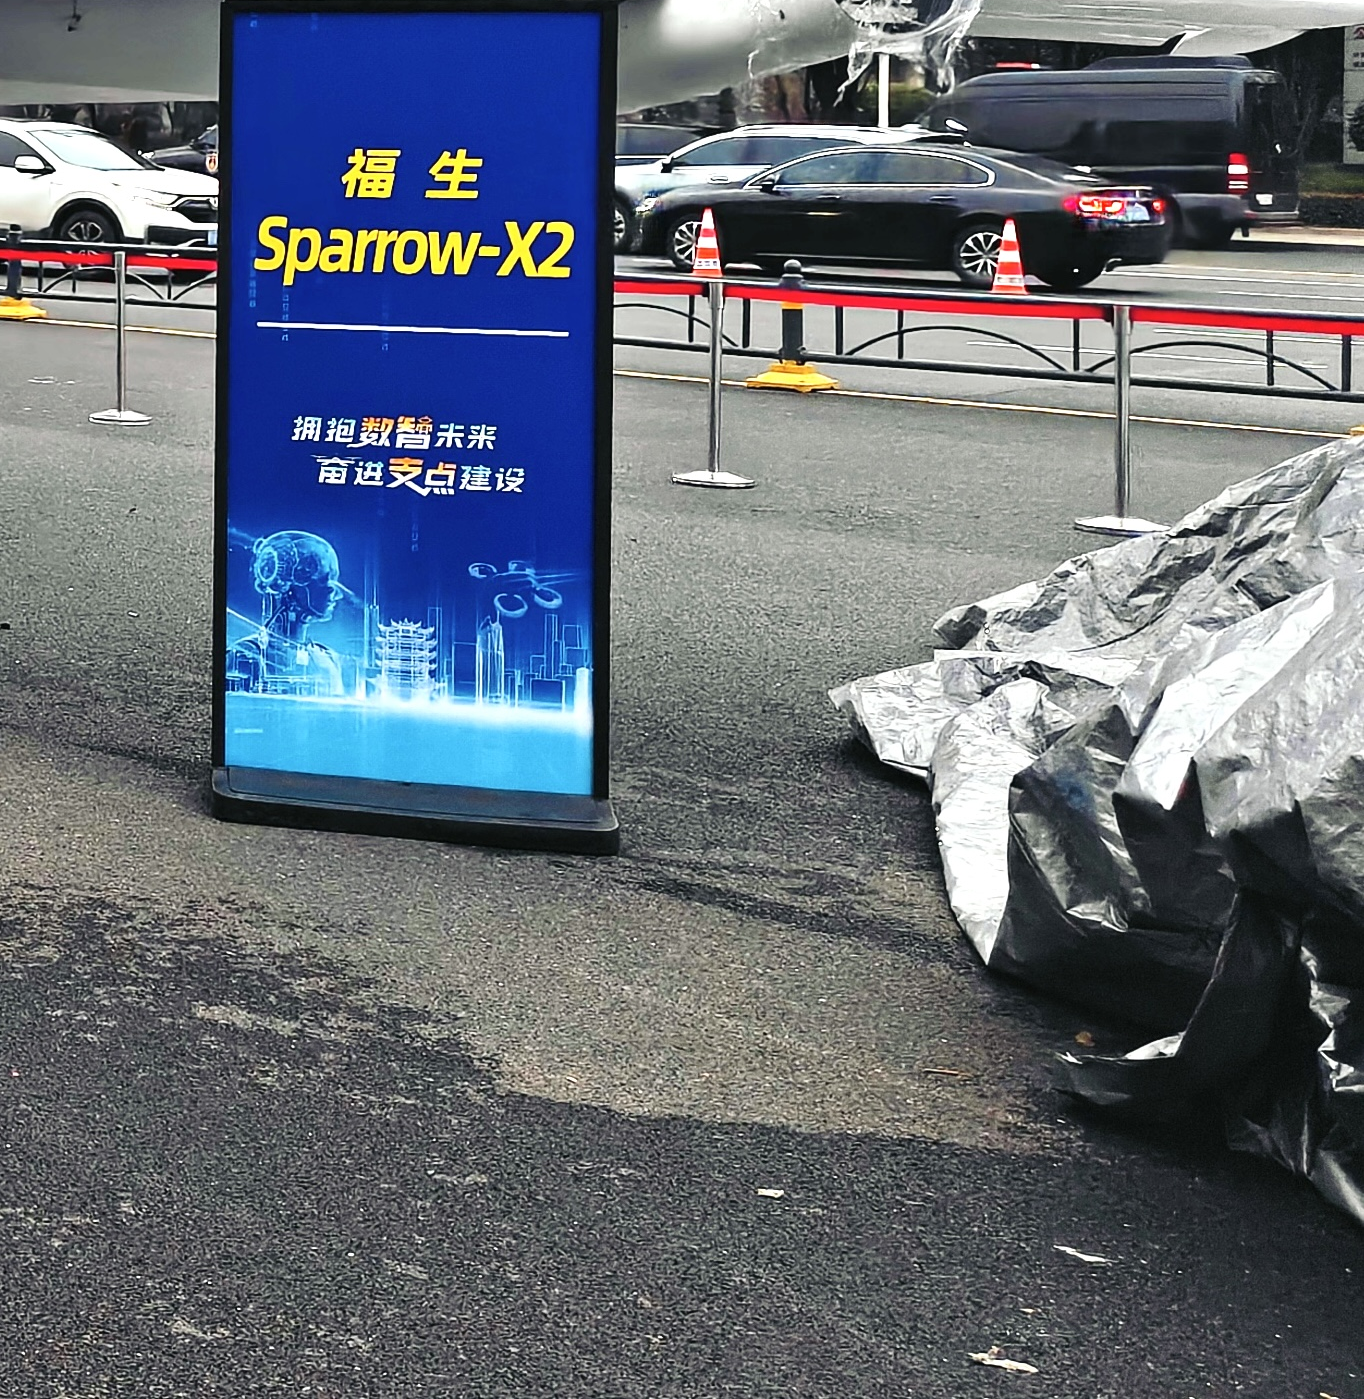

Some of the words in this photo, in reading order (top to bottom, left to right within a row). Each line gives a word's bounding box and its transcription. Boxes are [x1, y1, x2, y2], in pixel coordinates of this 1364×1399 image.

[341, 148, 483, 199] 福生
[253, 215, 575, 286] Sparrow-X2
[291, 415, 498, 450] 拥抱数智未来
[313, 455, 526, 497] 奋进支点建设
